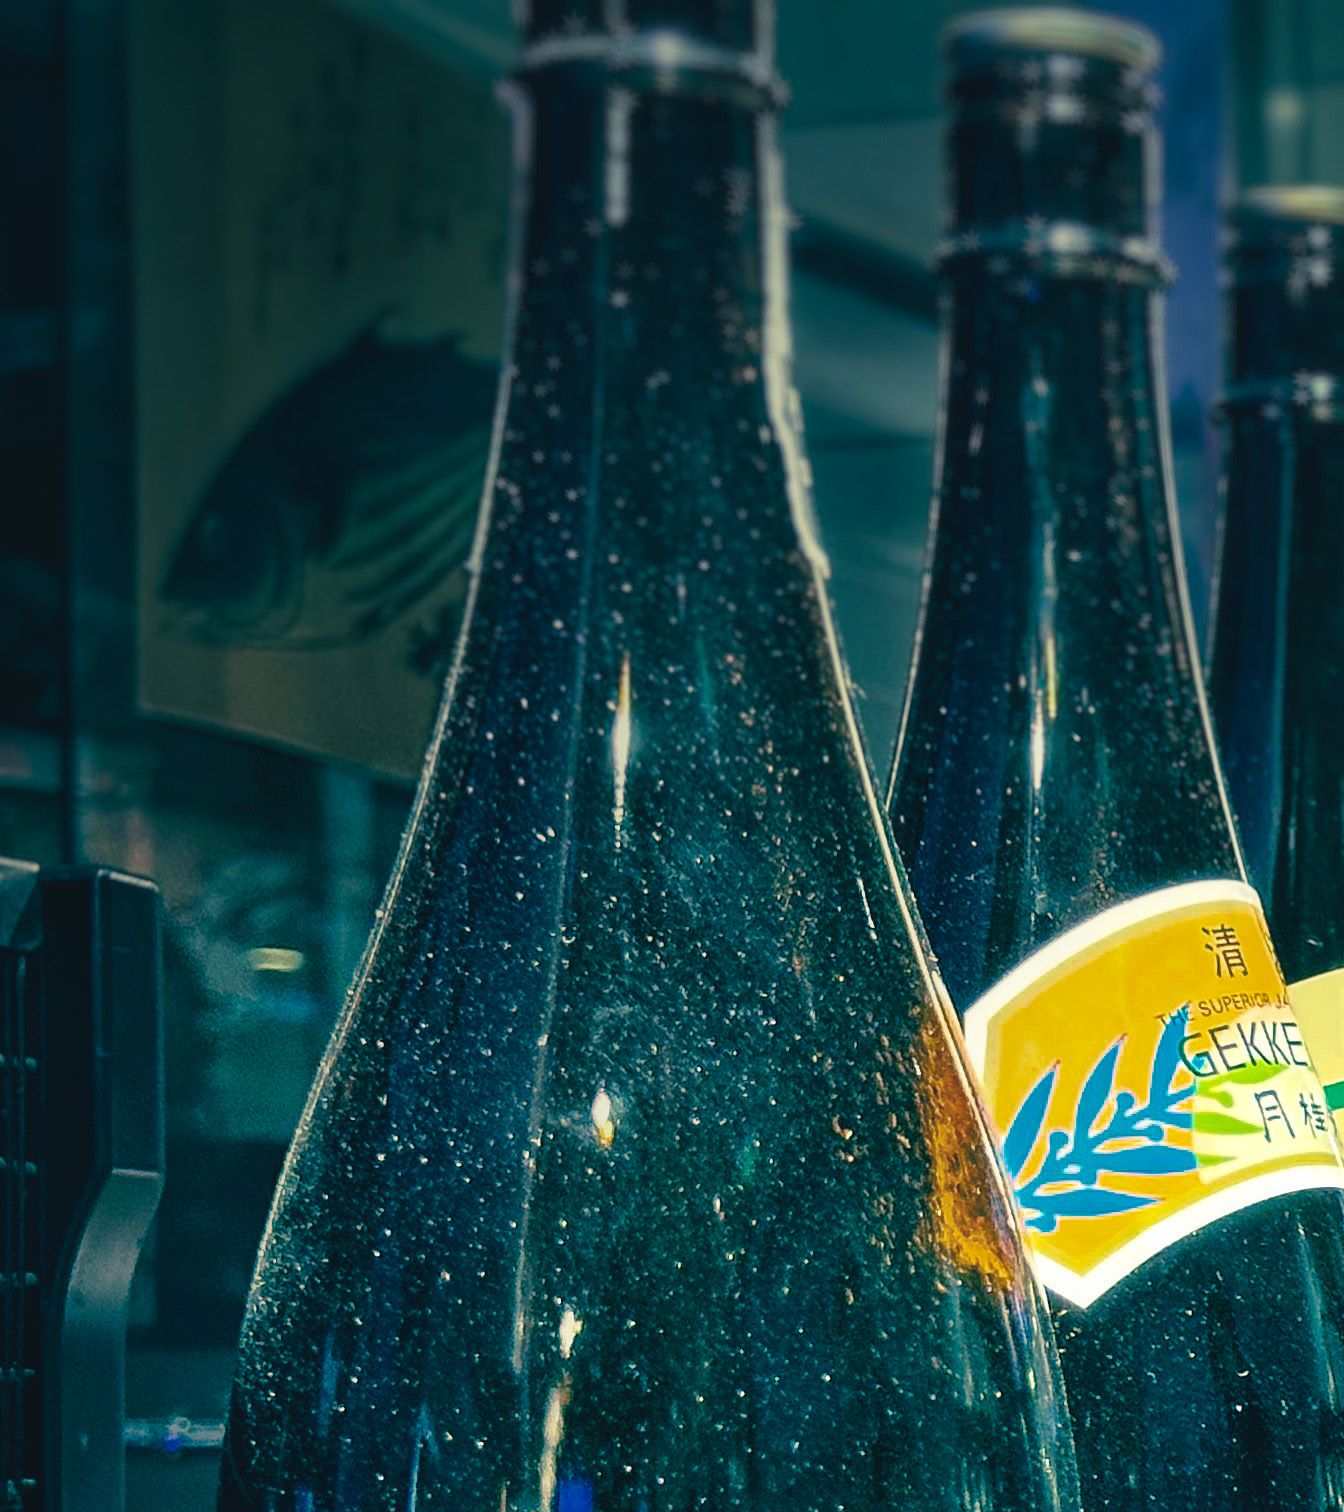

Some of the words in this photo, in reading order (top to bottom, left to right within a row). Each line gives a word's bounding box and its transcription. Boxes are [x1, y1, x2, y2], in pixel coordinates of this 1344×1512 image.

[1197, 992, 1270, 1018] SUPERIOR
[1178, 1020, 1309, 1077] GEKKE
[1253, 1089, 1328, 1143] 月桂
